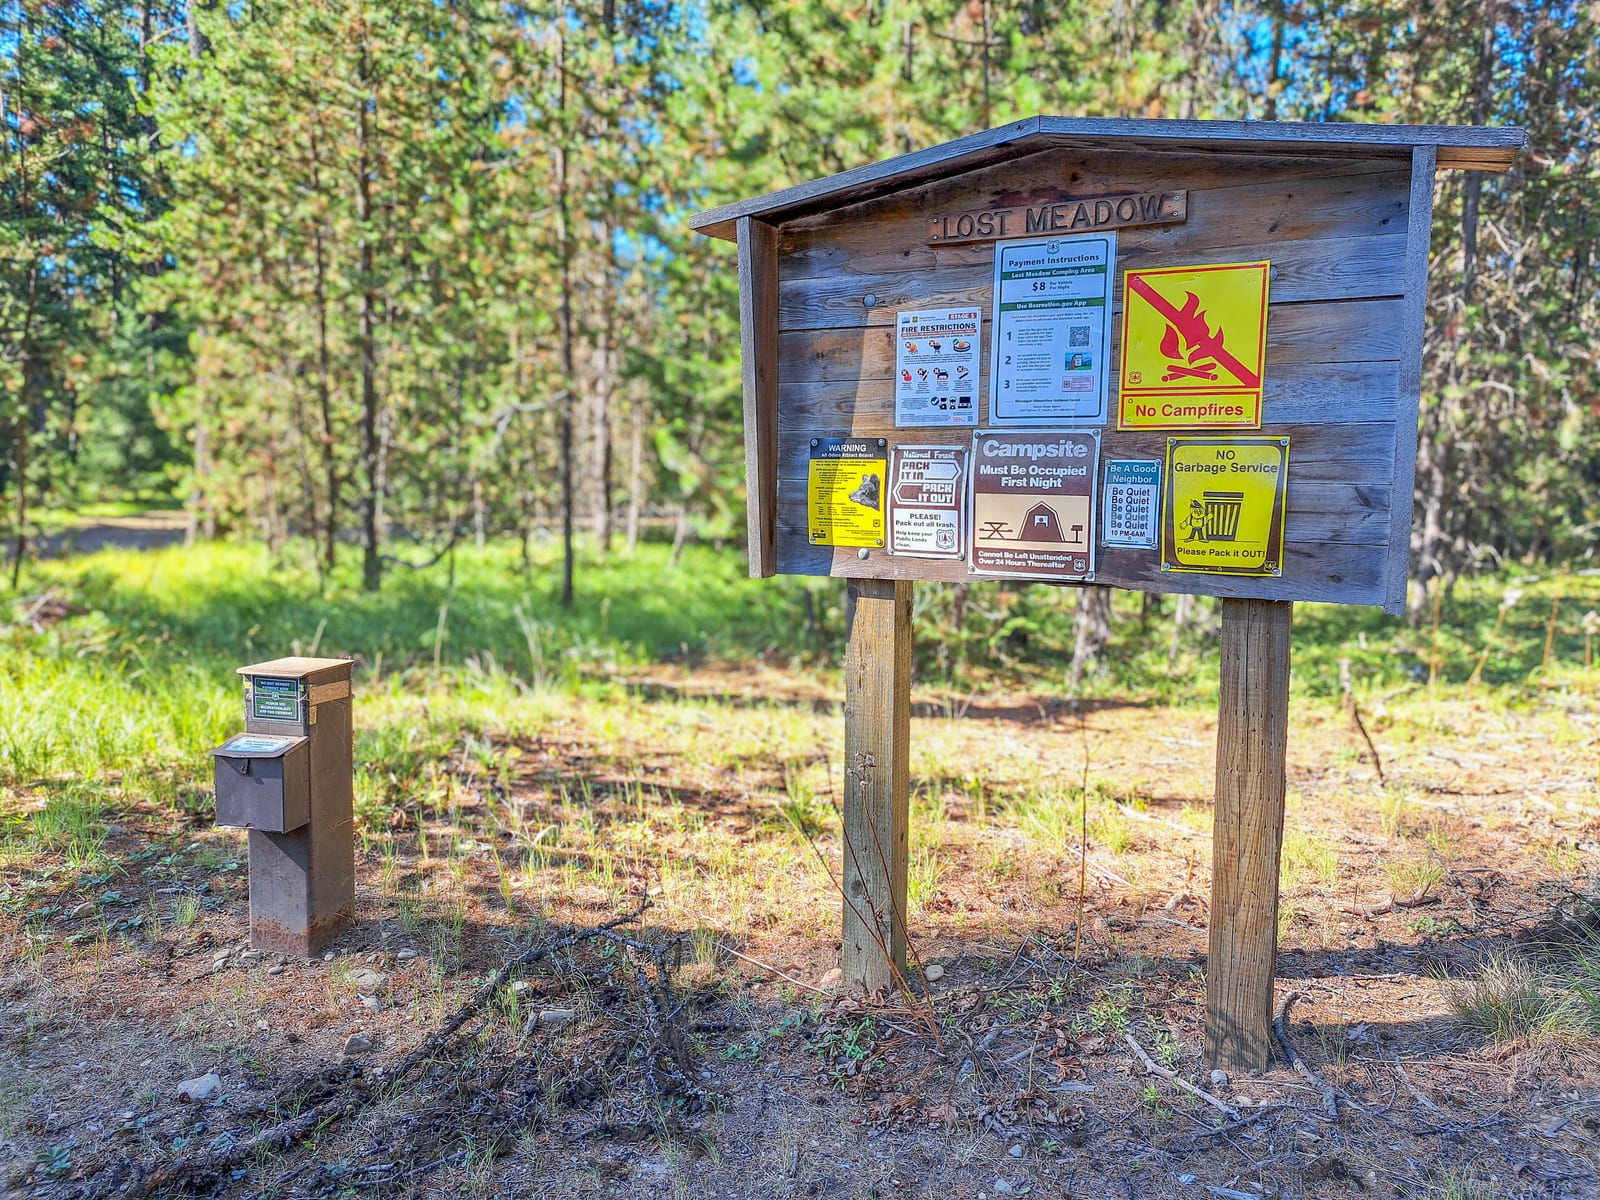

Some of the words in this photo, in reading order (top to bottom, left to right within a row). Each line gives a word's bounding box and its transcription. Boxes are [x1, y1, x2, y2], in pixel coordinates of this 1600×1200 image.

[943, 211, 1012, 240] LOST
[1026, 194, 1166, 234] MEADOW
[1008, 258, 1044, 268] Payment
[1048, 254, 1100, 264] Instructions
[1032, 282, 1046, 292] $8
[920, 323, 976, 332] RESTRICTIONS
[1006, 332, 1012, 341] 1
[1005, 356, 1012, 365] 2
[1004, 380, 1010, 389] 3
[1136, 404, 1156, 416] No
[1162, 404, 1244, 419] Campfires
[983, 440, 1088, 460] Campsite
[1216, 450, 1235, 460] NO
[902, 462, 930, 470] PACK
[1175, 462, 1226, 474] Garbage
[1231, 463, 1278, 473] Service
[980, 465, 1008, 474] Must
[1010, 465, 1026, 474] Be
[1029, 465, 1087, 477] Occupied
[1001, 477, 1027, 486] First
[1030, 478, 1062, 489] Night
[1112, 475, 1152, 485] Neighbor
[922, 484, 953, 492] PACK
[1127, 488, 1150, 496] Quiet
[918, 494, 929, 502] IT
[930, 494, 953, 503] OUT
[1126, 496, 1150, 504] Quiet
[1126, 505, 1149, 513] Quiet
[1125, 513, 1148, 521] Quiet
[1125, 521, 1148, 529] Quiet
[1030, 553, 1072, 561] Unattended
